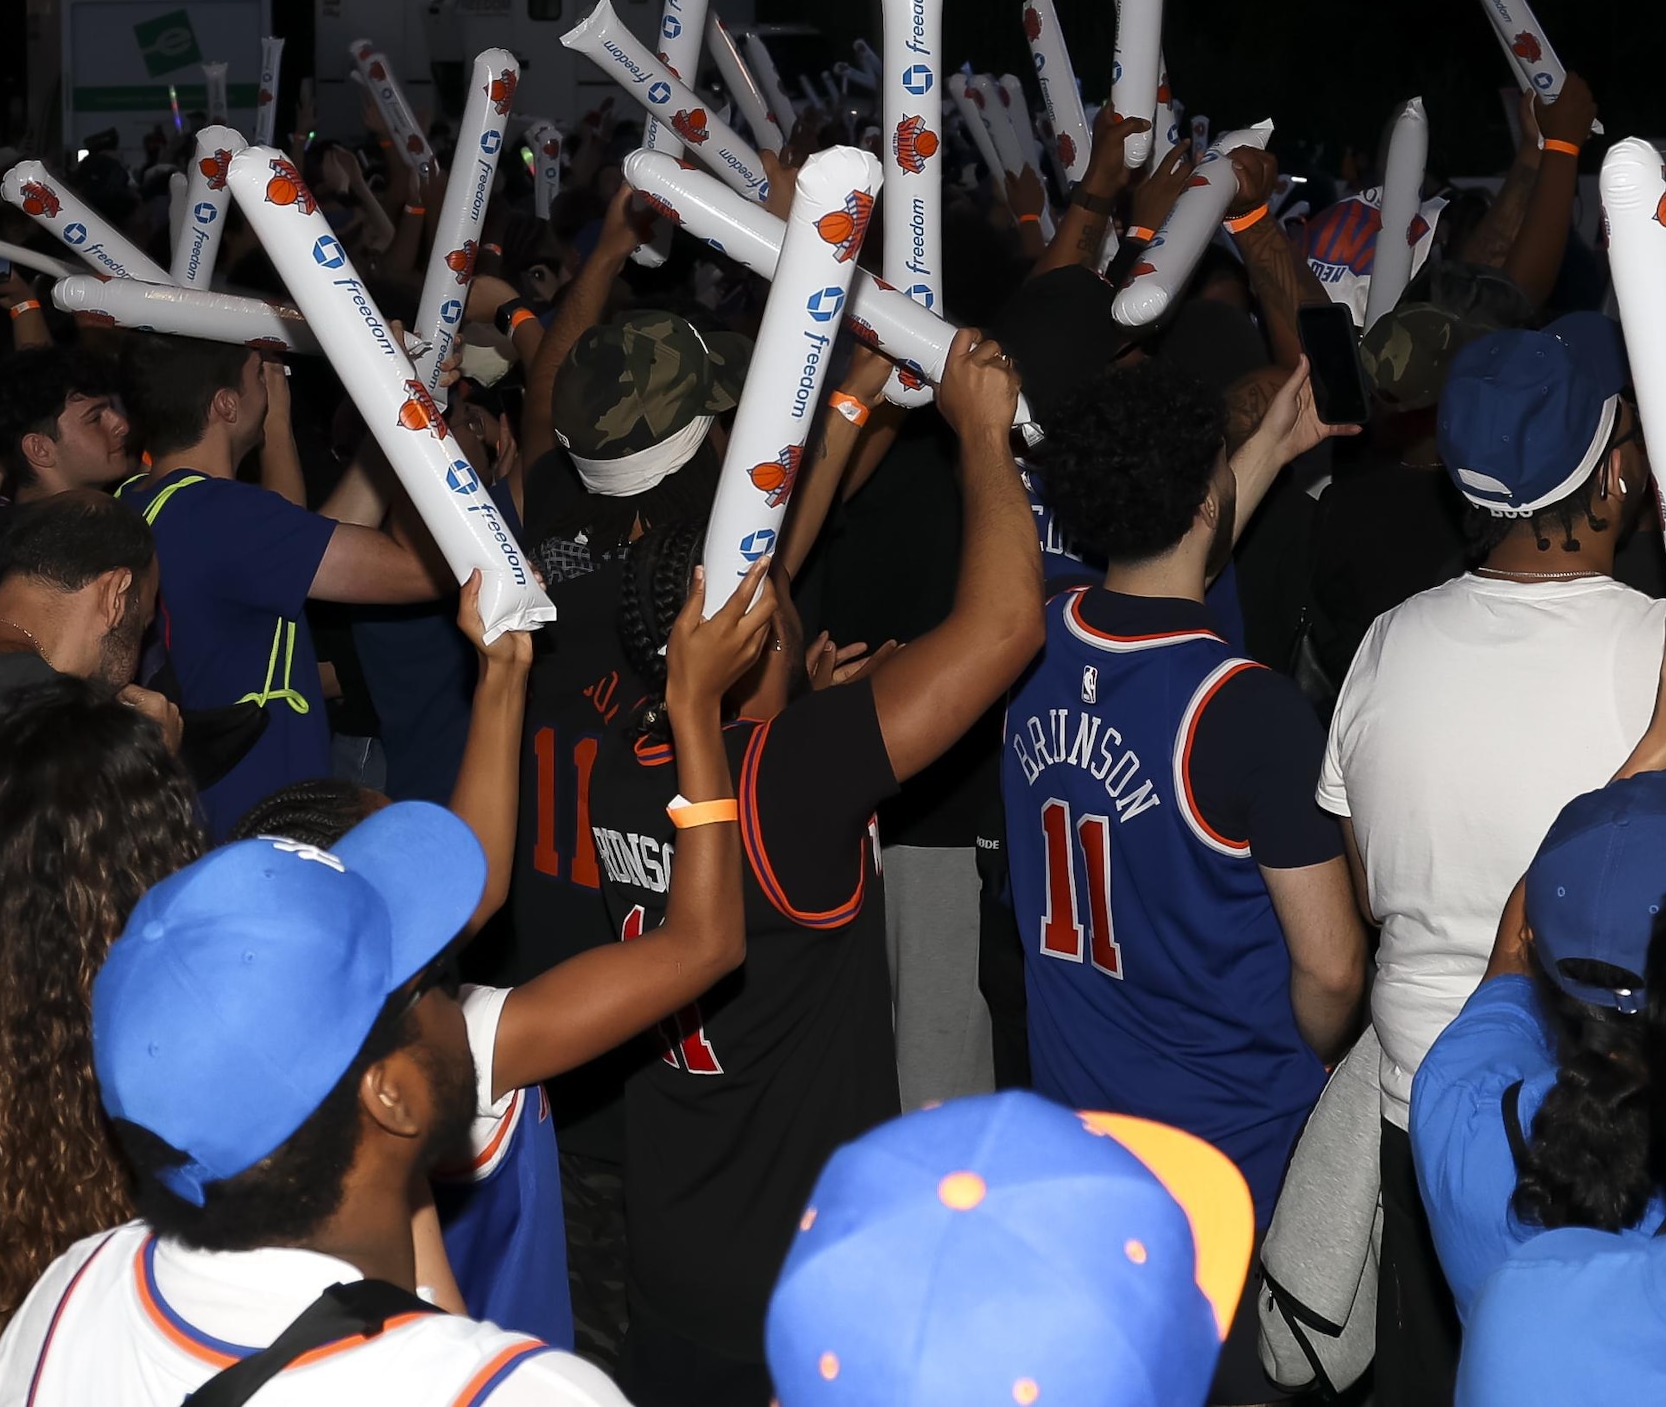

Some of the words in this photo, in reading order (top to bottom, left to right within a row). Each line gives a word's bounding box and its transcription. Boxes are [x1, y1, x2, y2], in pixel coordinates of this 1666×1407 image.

[603, 39, 654, 84] freedom
[1038, 77, 1057, 122] freedom
[471, 159, 493, 222] freedom
[717, 147, 767, 190] freedom
[186, 226, 210, 282] freedom
[905, 198, 931, 275] freedom
[333, 277, 394, 356] freedom
[429, 328, 453, 391] freedom
[791, 331, 830, 418] freedom
[467, 502, 527, 587] freedom
[1013, 708, 1161, 823] BRUNSON
[534, 726, 602, 890] 11
[1040, 797, 1124, 981] 11
